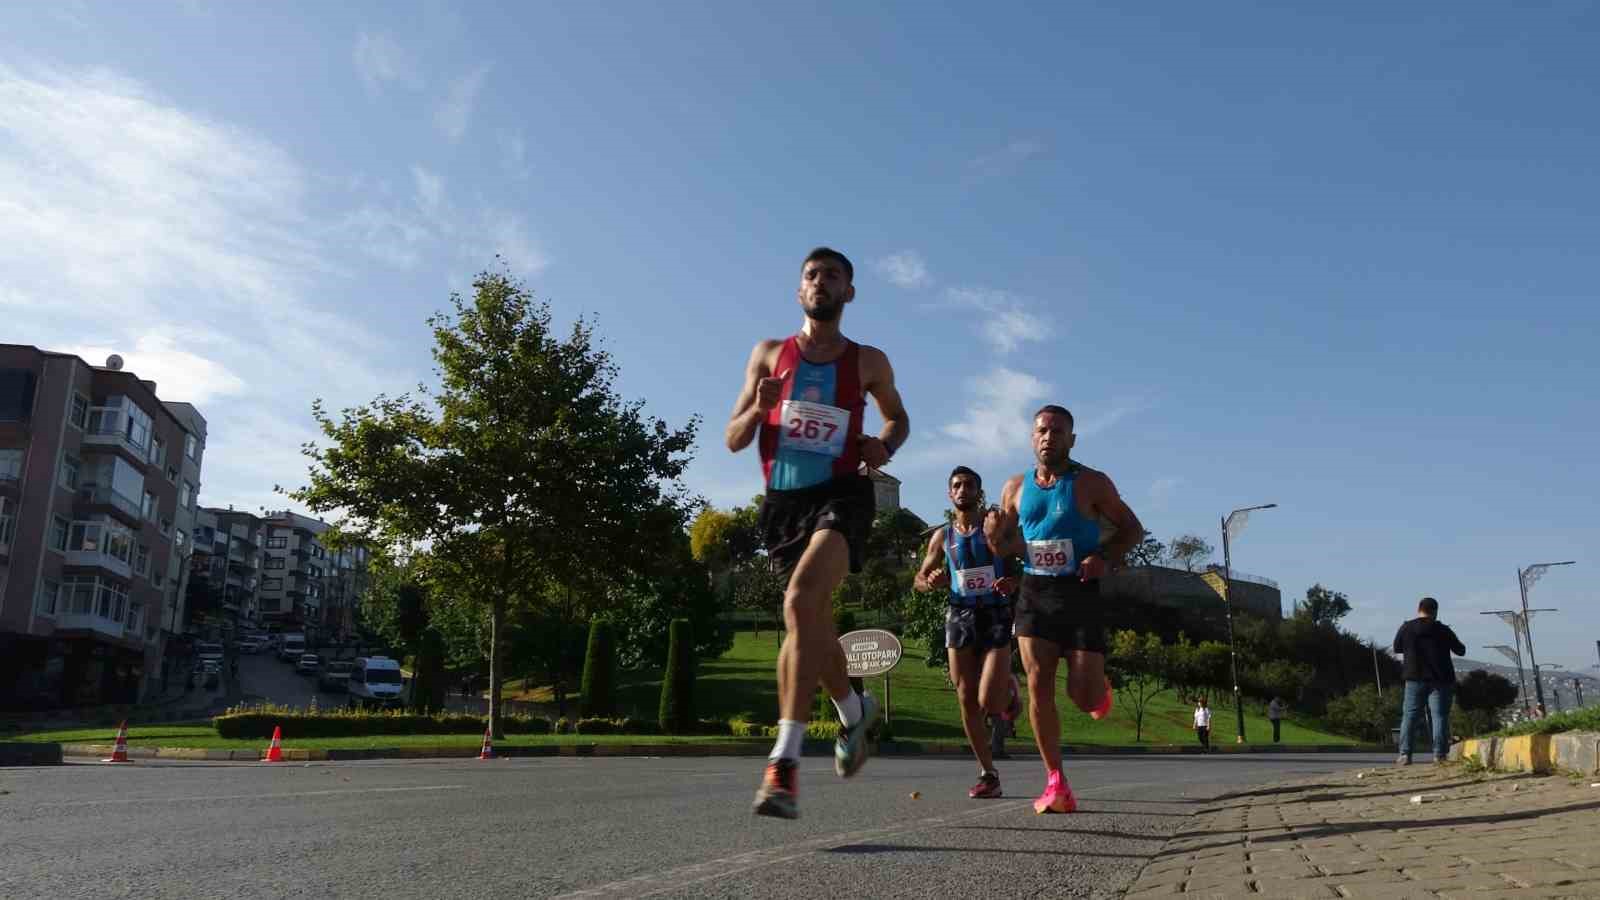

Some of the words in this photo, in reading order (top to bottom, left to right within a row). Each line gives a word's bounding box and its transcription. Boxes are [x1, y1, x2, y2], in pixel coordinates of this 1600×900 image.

[787, 418, 838, 442] 267
[1034, 551, 1067, 567] 299
[966, 577, 986, 590] 62
